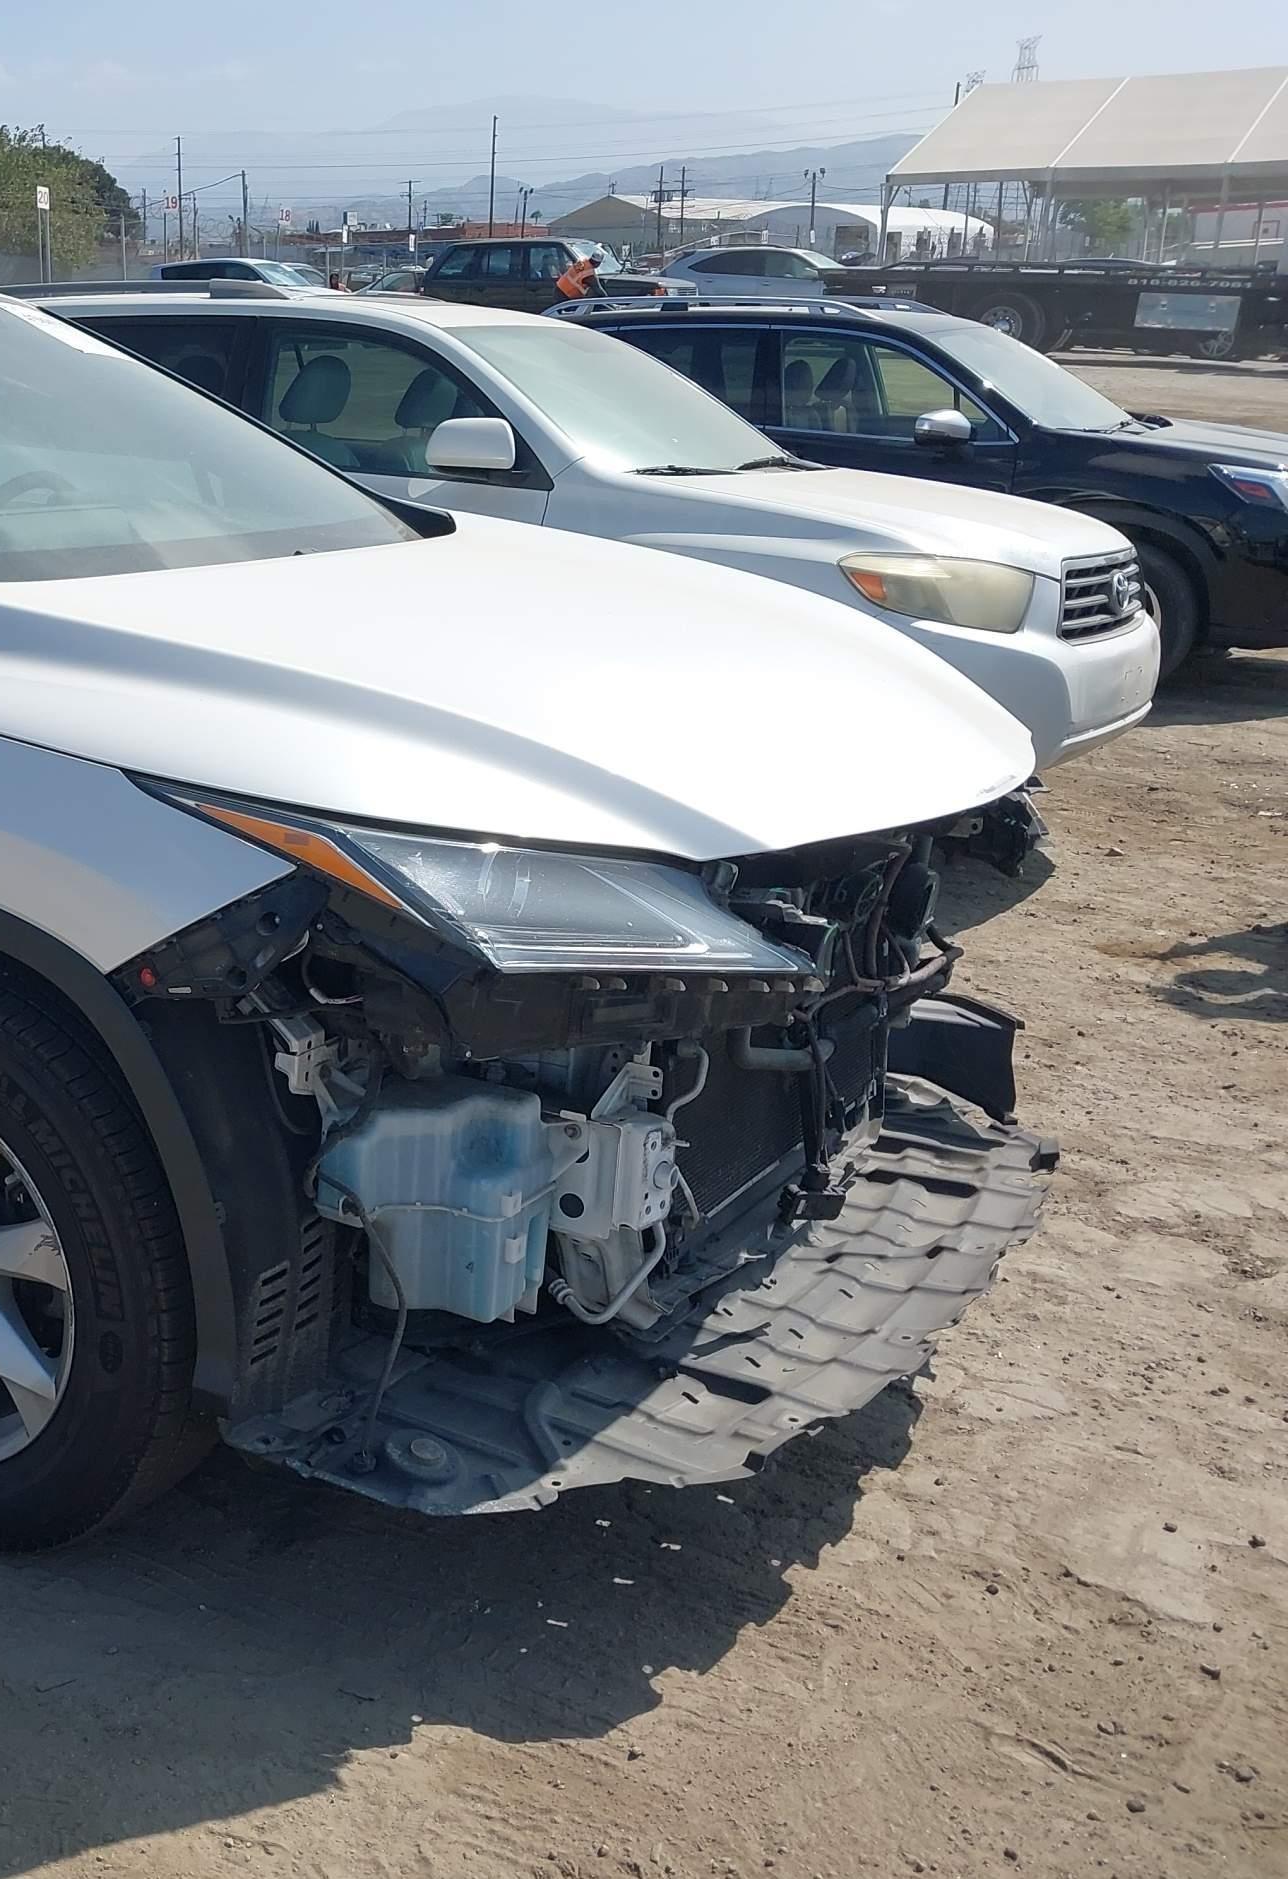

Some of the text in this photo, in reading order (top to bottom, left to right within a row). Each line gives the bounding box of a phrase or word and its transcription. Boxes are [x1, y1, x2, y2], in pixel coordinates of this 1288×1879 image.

[38, 190, 49, 206] 20
[164, 195, 178, 209] 19
[279, 209, 291, 222] 18
[27, 1114, 125, 1321] MICHELIN
